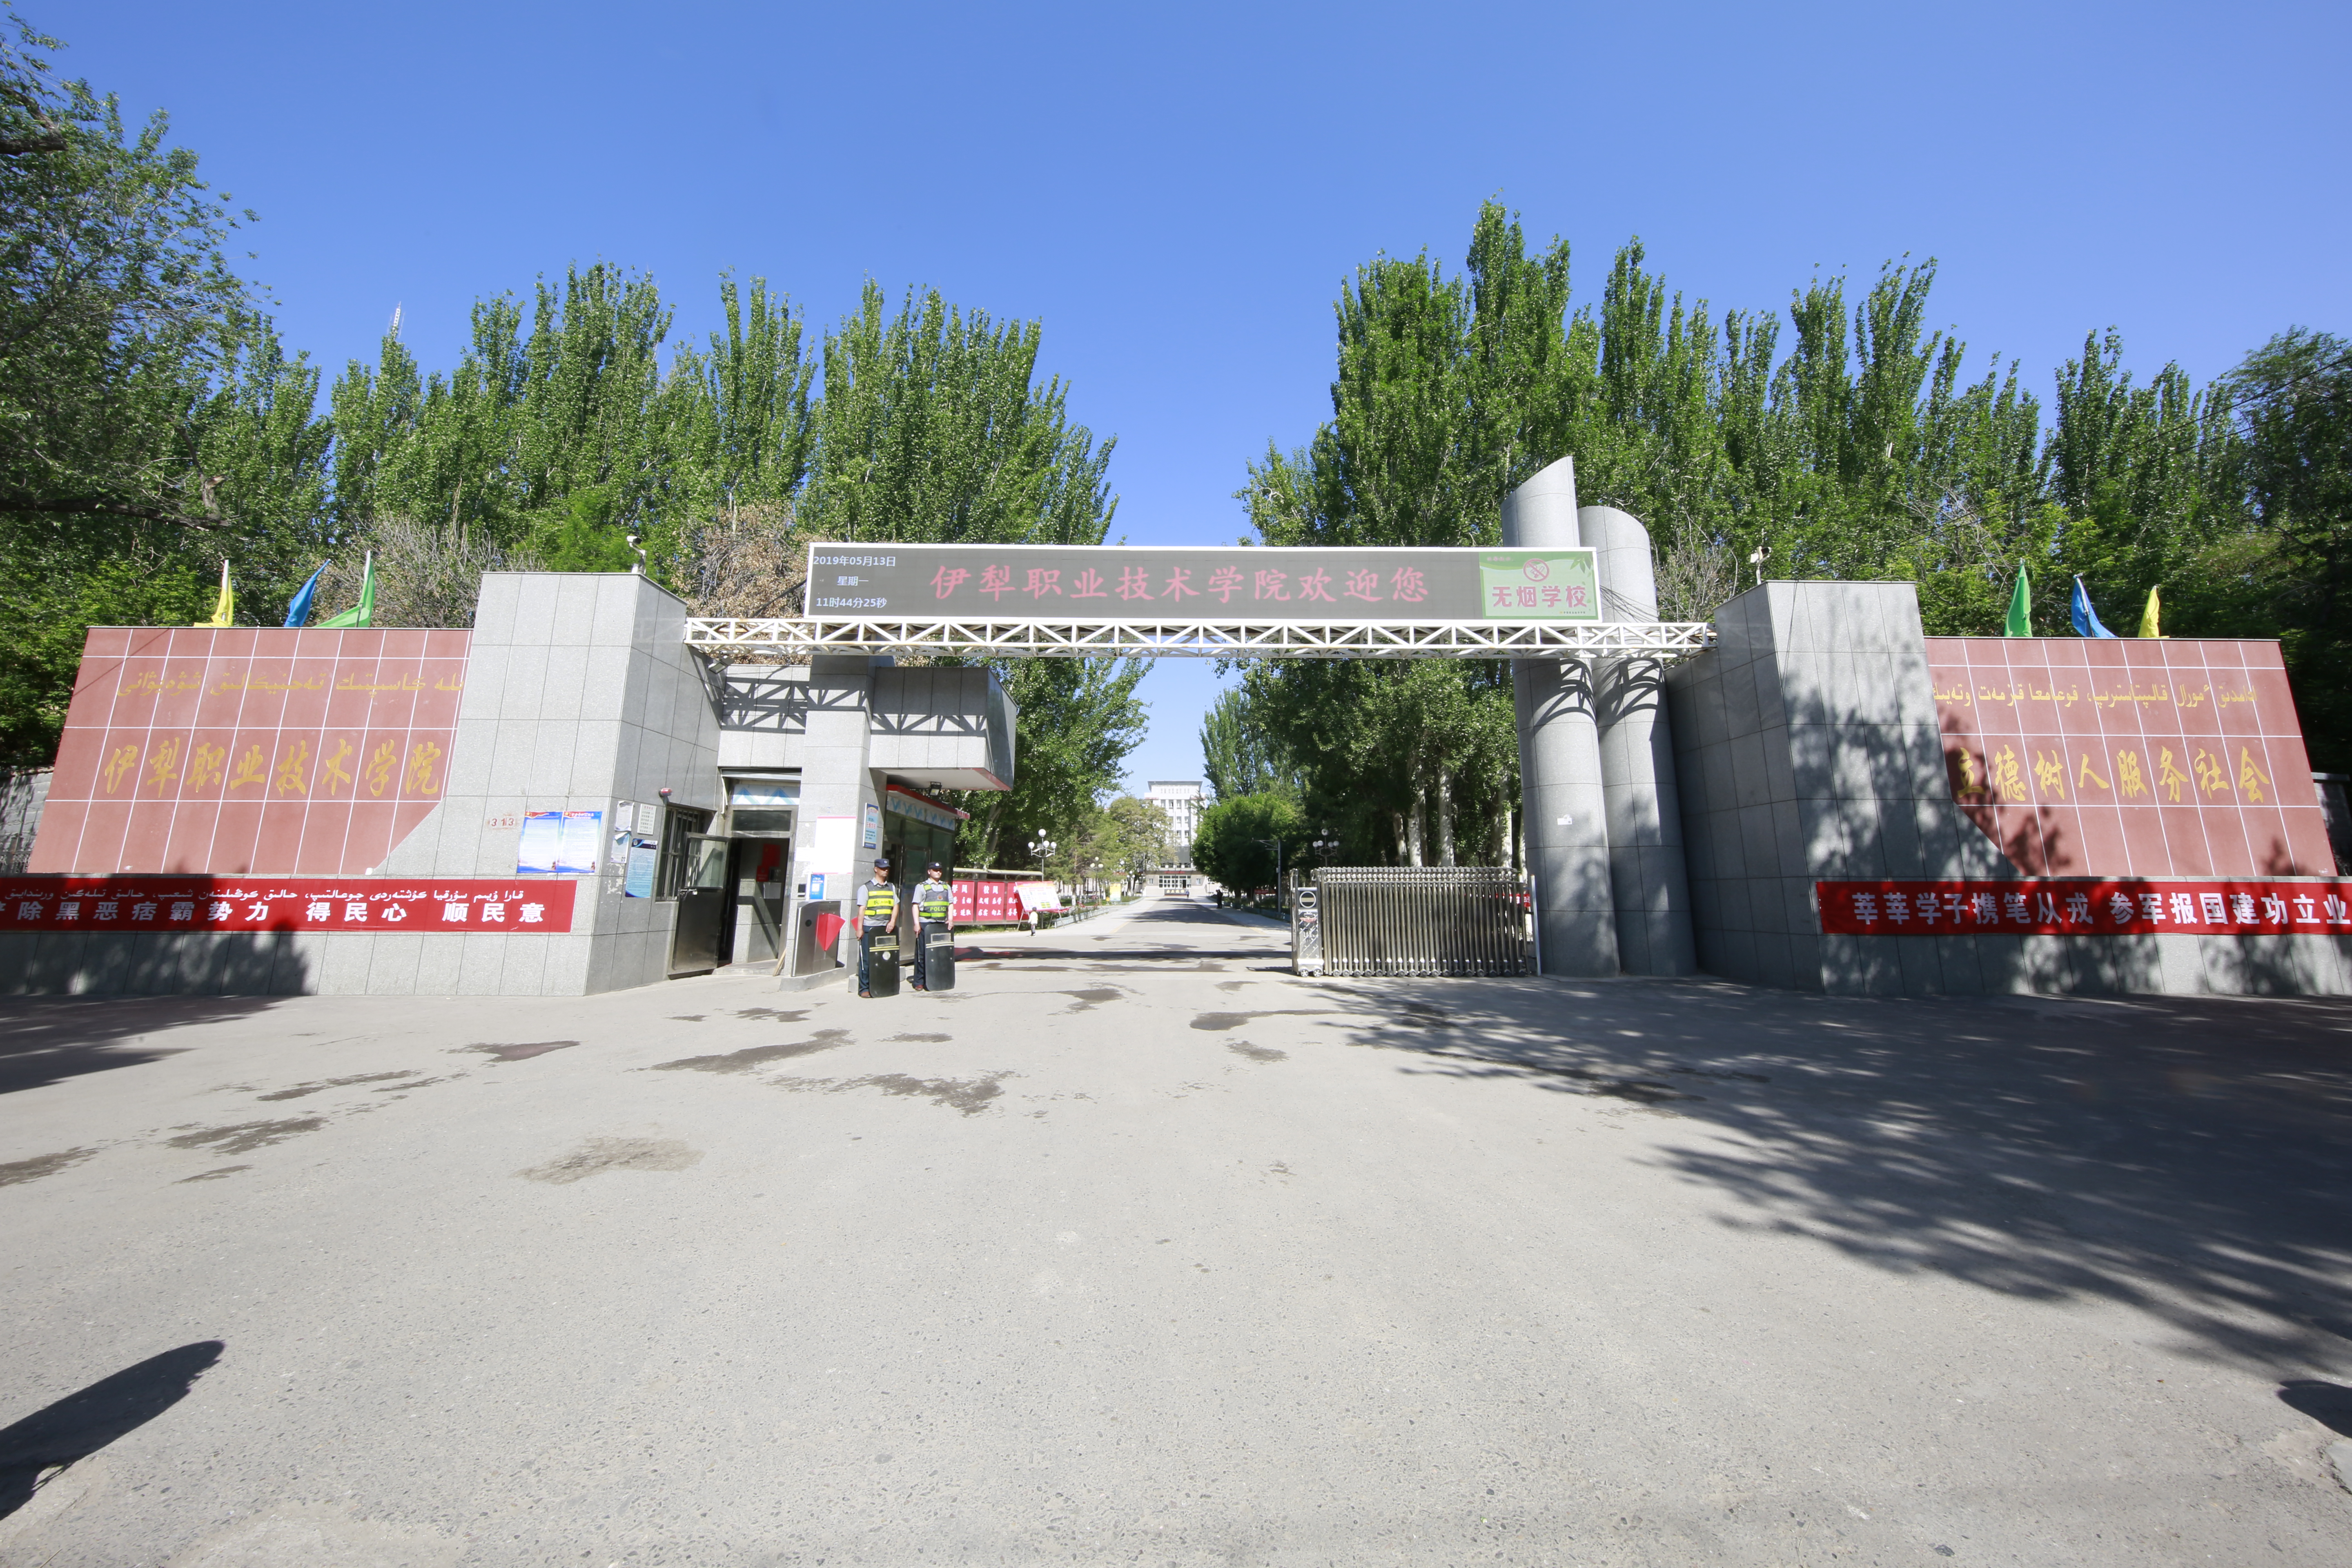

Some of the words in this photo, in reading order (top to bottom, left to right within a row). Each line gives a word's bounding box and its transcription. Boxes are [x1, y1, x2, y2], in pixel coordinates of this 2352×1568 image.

[813, 555, 895, 567] 2019年05月13日
[837, 576, 869, 586] 星期一
[930, 565, 1428, 604] 伊犁职业技术学院欢迎您
[816, 597, 887, 608] 11时44分25秒
[1492, 586, 1587, 608] 无烟学校
[105, 737, 441, 798] 伊犁职业技术学院
[1957, 744, 2270, 804] 立德树人服务社会
[305, 902, 407, 922] 得民心
[442, 903, 545, 923] 顺民意
[1852, 892, 2093, 925] 莘莘学子携笔从戎
[2109, 891, 2351, 925] 参军报国建功立业
